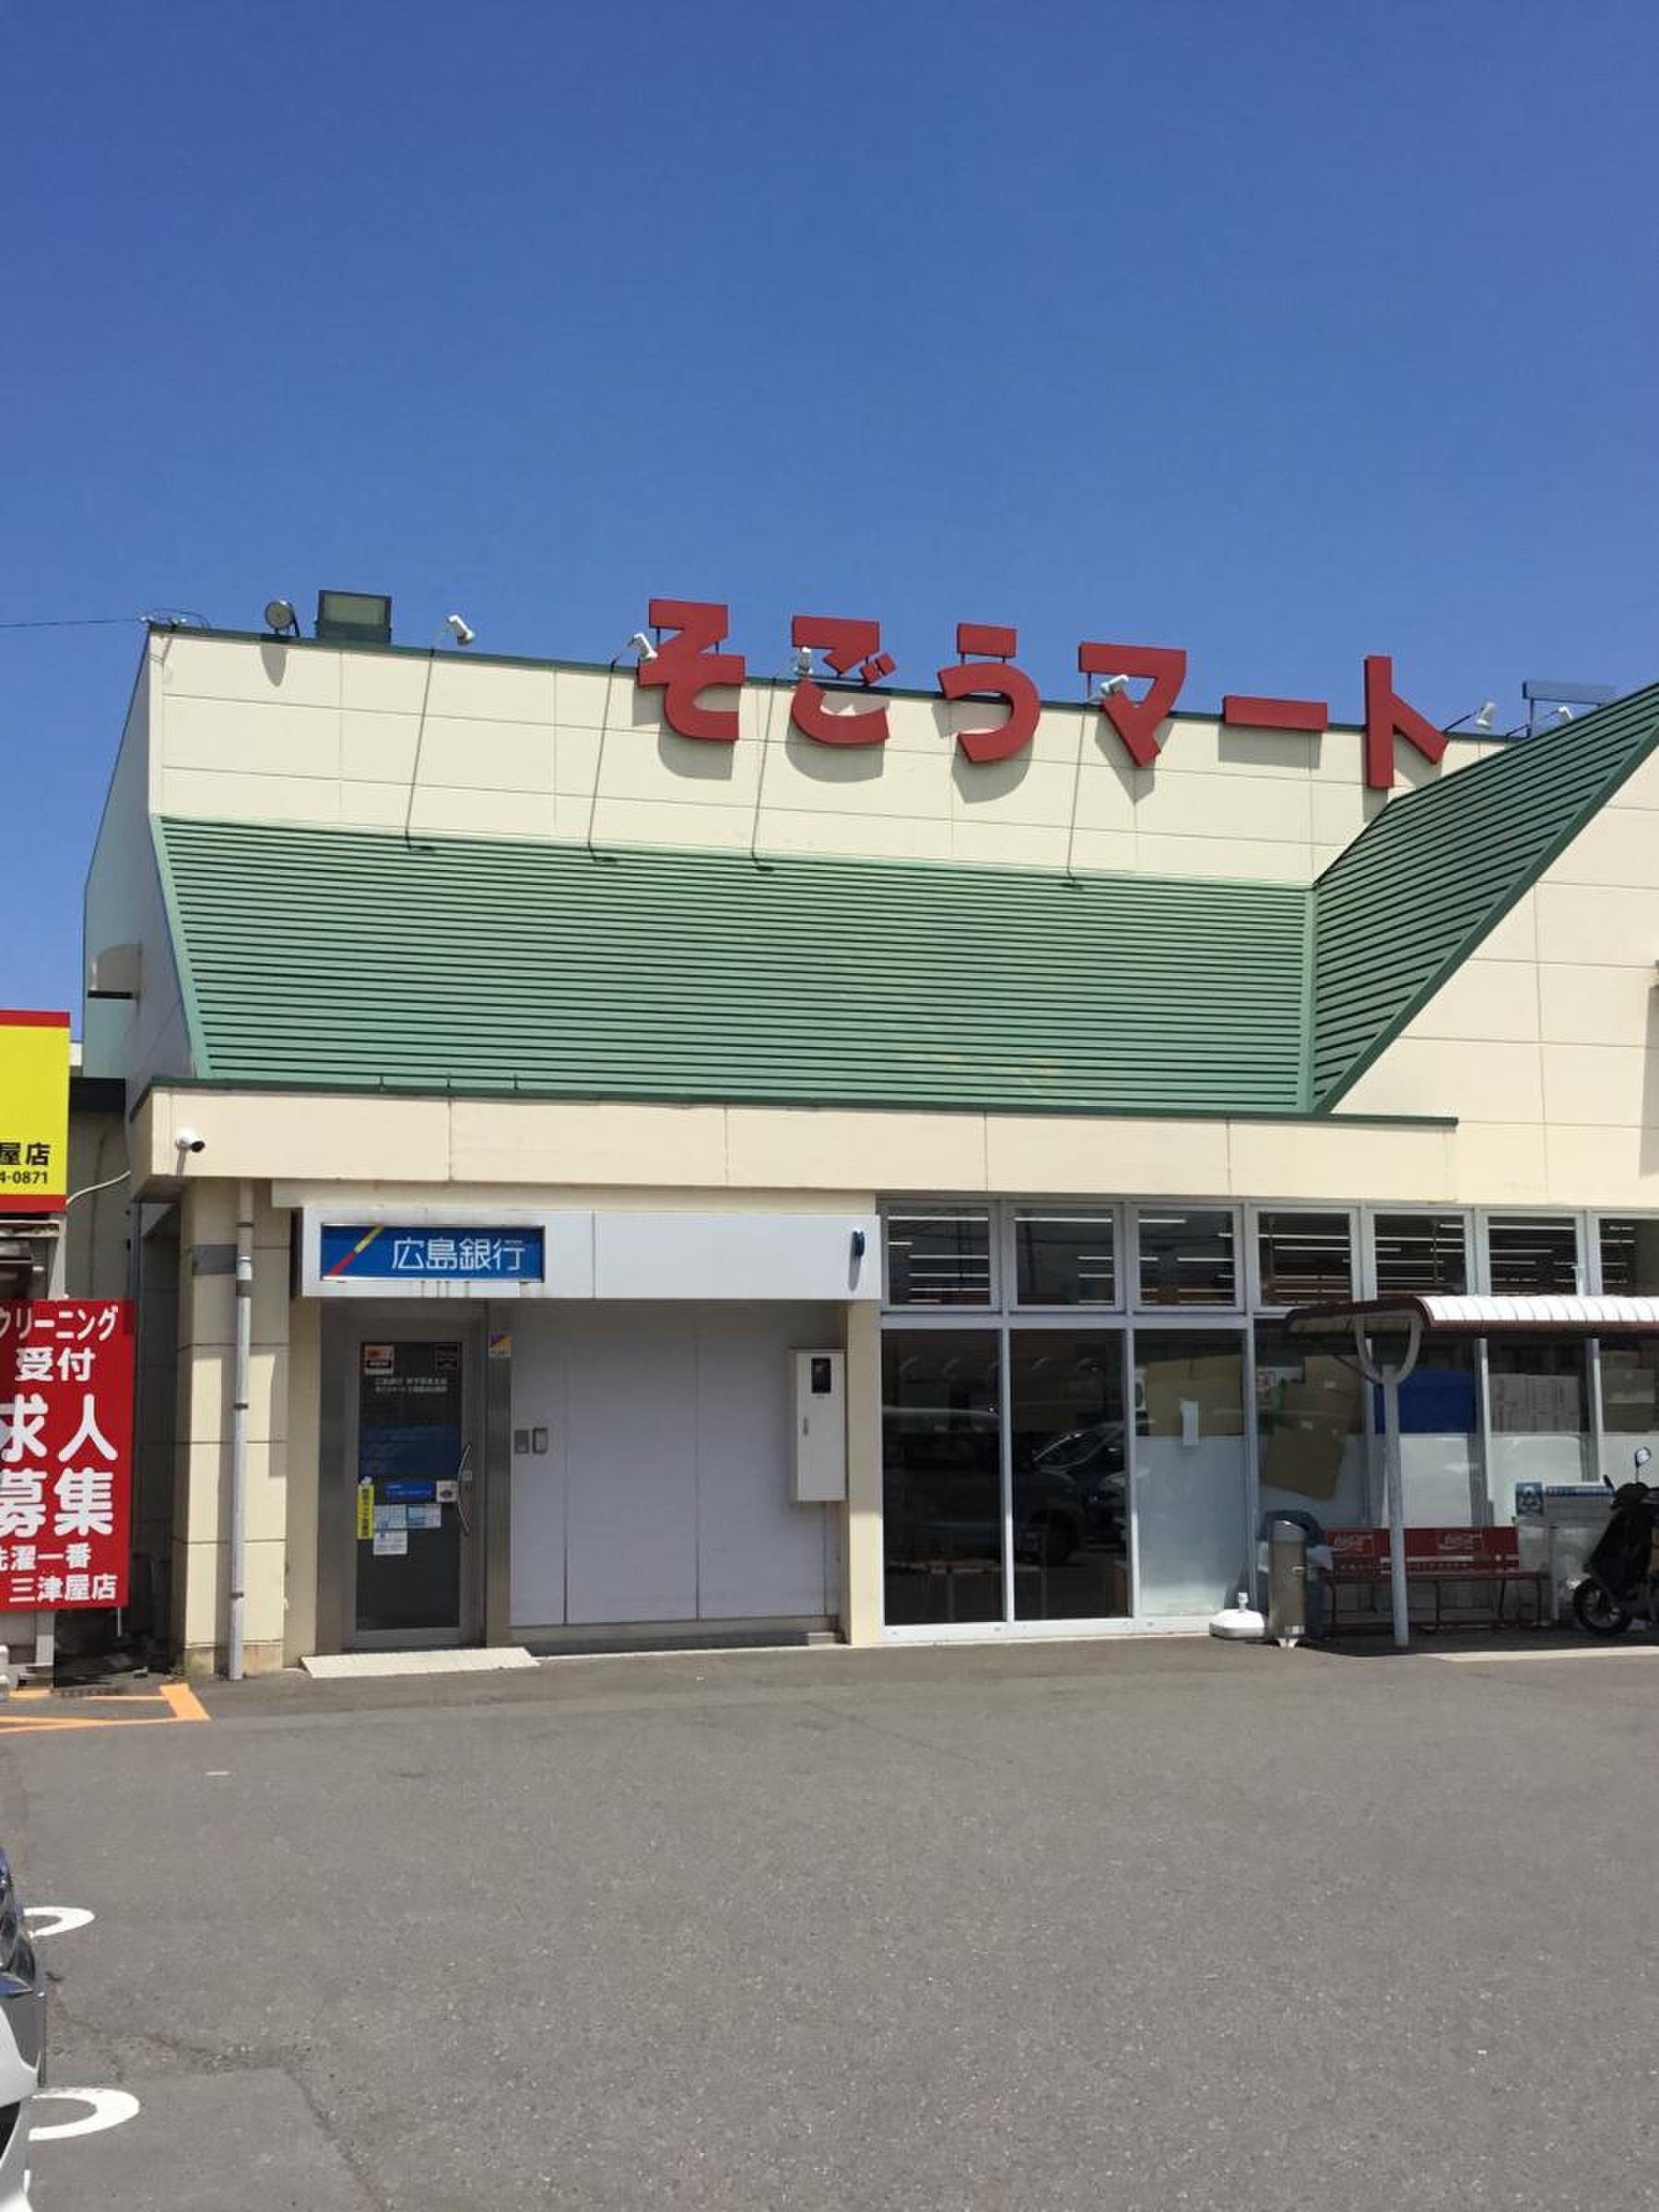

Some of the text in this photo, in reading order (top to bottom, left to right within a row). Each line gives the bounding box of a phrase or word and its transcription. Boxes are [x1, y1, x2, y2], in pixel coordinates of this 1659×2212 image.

[638, 598, 1447, 789] そごうマート
[391, 1237, 525, 1271] 広島銀行
[0, 1305, 118, 1341] クリーニング
[15, 1347, 96, 1382] 受付
[0, 1394, 118, 1462] 求人
[0, 1467, 113, 1537] 募集
[9, 1573, 118, 1603] 三津屋店
